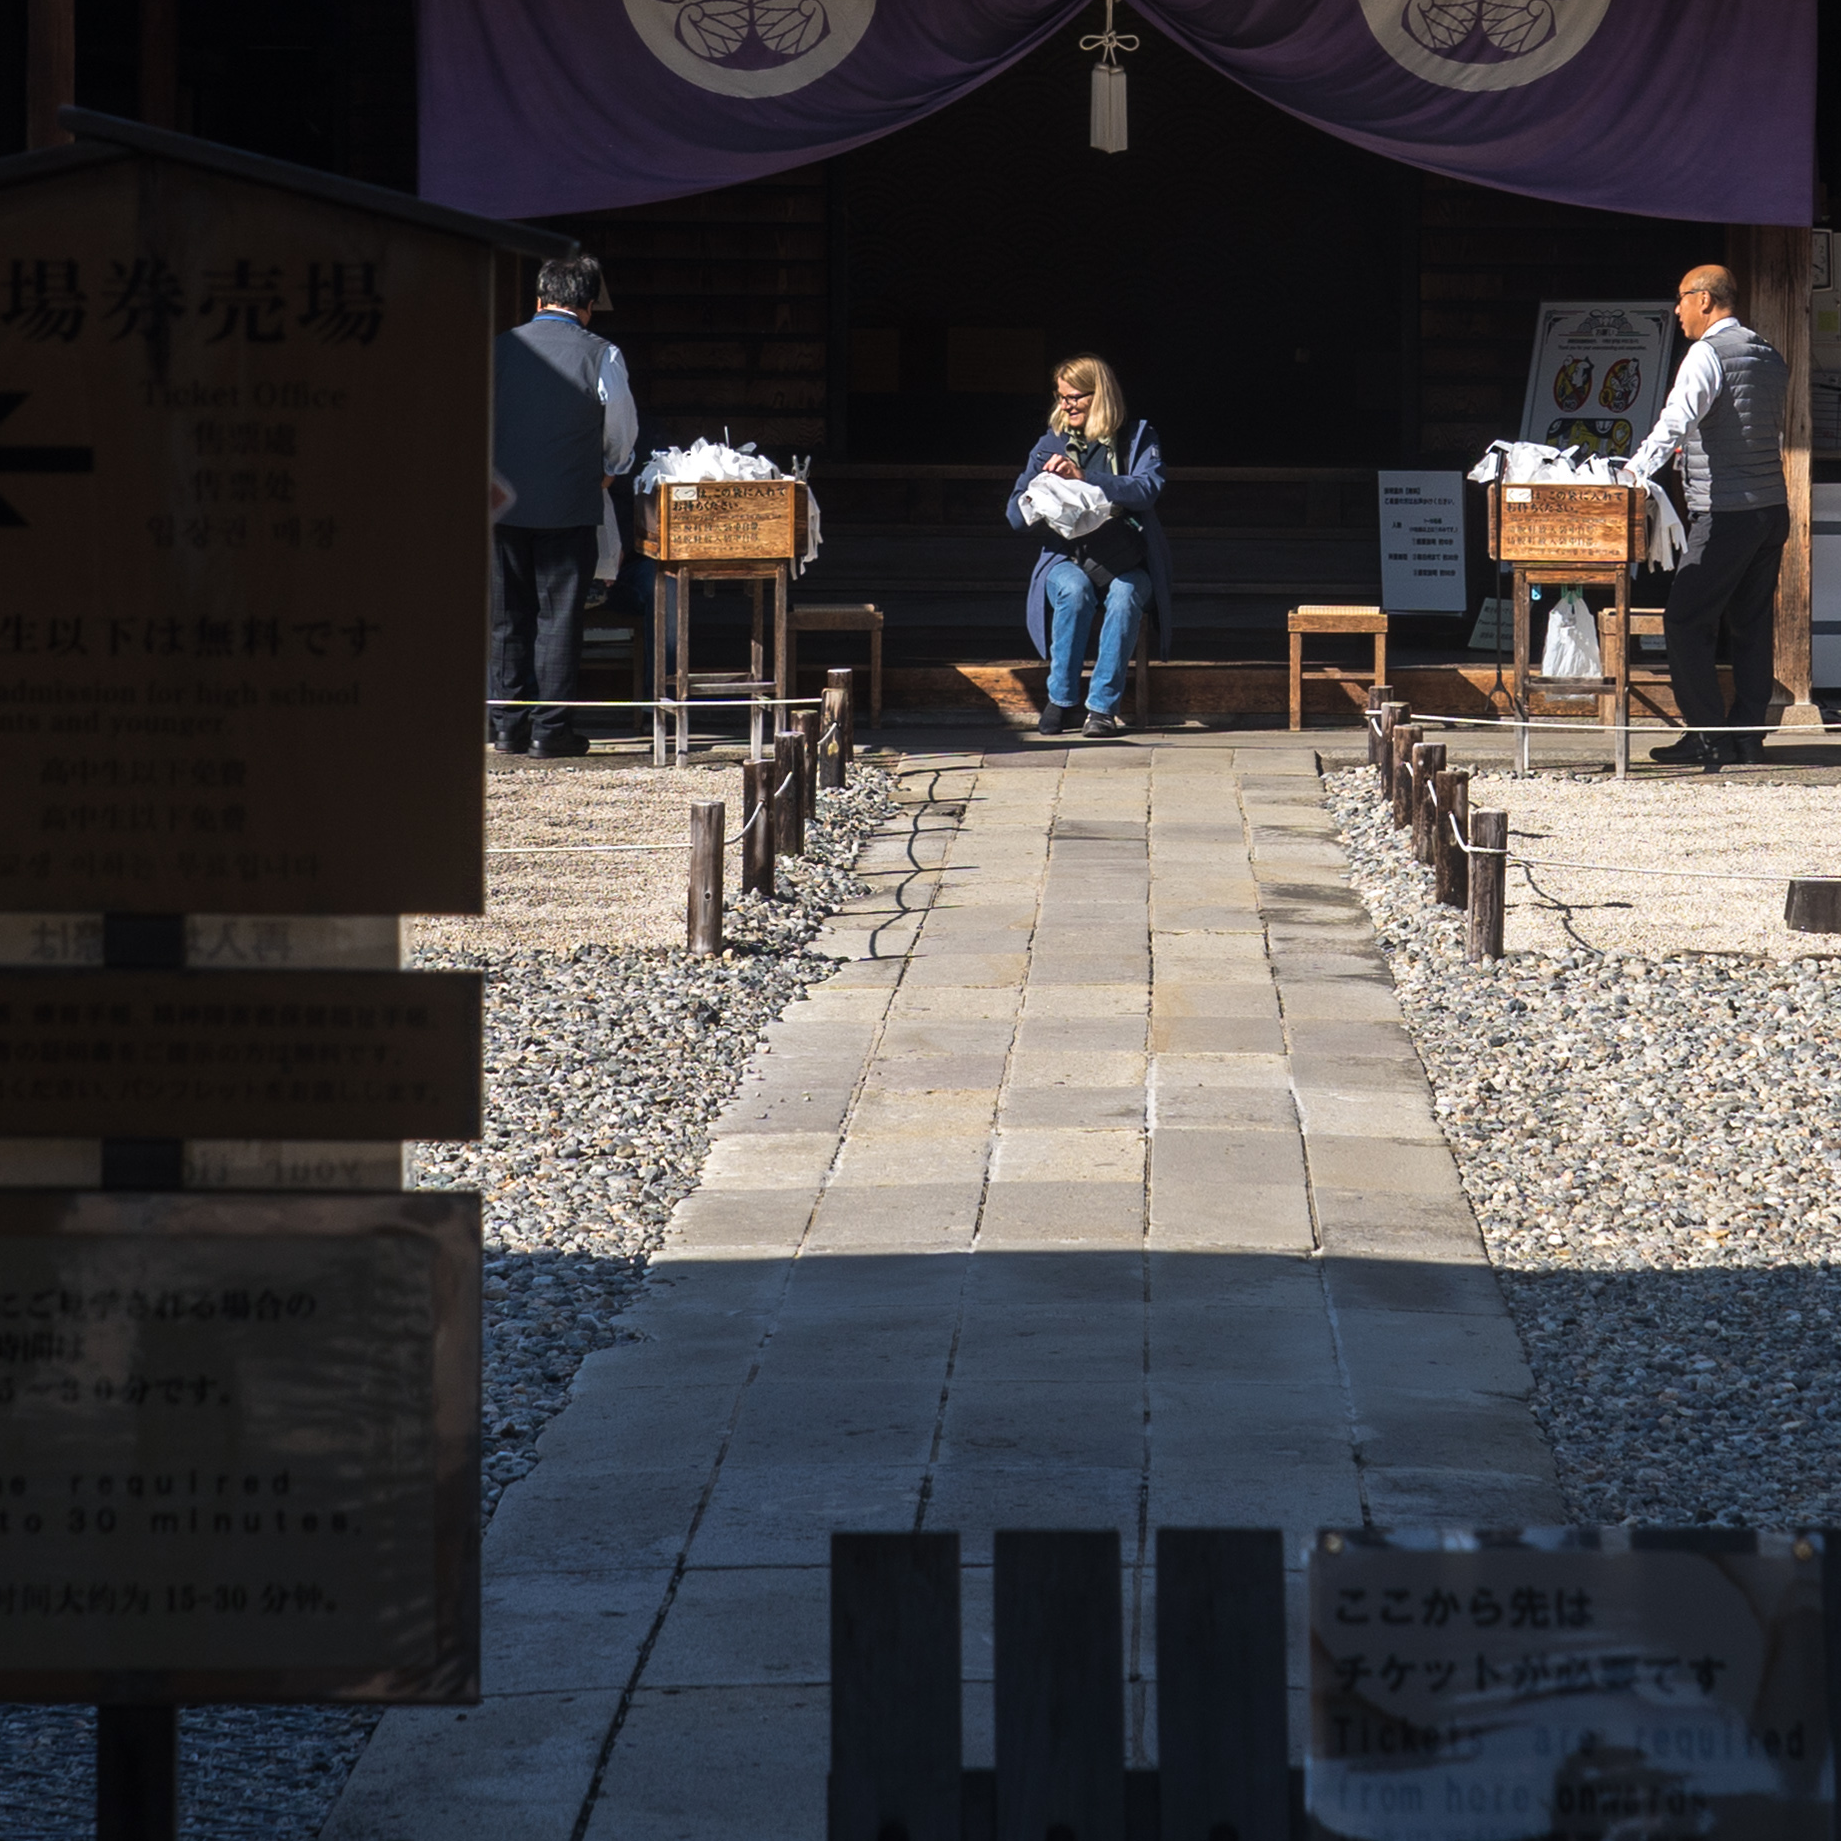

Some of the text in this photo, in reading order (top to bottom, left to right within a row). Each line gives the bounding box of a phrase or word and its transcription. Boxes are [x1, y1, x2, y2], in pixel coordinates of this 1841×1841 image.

[140, 378, 348, 409] Ticket Office
[146, 679, 185, 705] for
[195, 679, 259, 710] high
[269, 680, 361, 707] school
[49, 709, 100, 734] and
[67, 1468, 293, 1501] required
[66, 1505, 119, 1536] 30
[148, 1505, 363, 1537] minutes.
[165, 1582, 250, 1615] 15-30
[1335, 1588, 1594, 1629] ここから先は
[1335, 1650, 1728, 1694] チケットが必要です
[1333, 1715, 1807, 1763] Tickets are required
[1338, 1773, 1423, 1814] from
[1444, 1771, 1531, 1814] here
